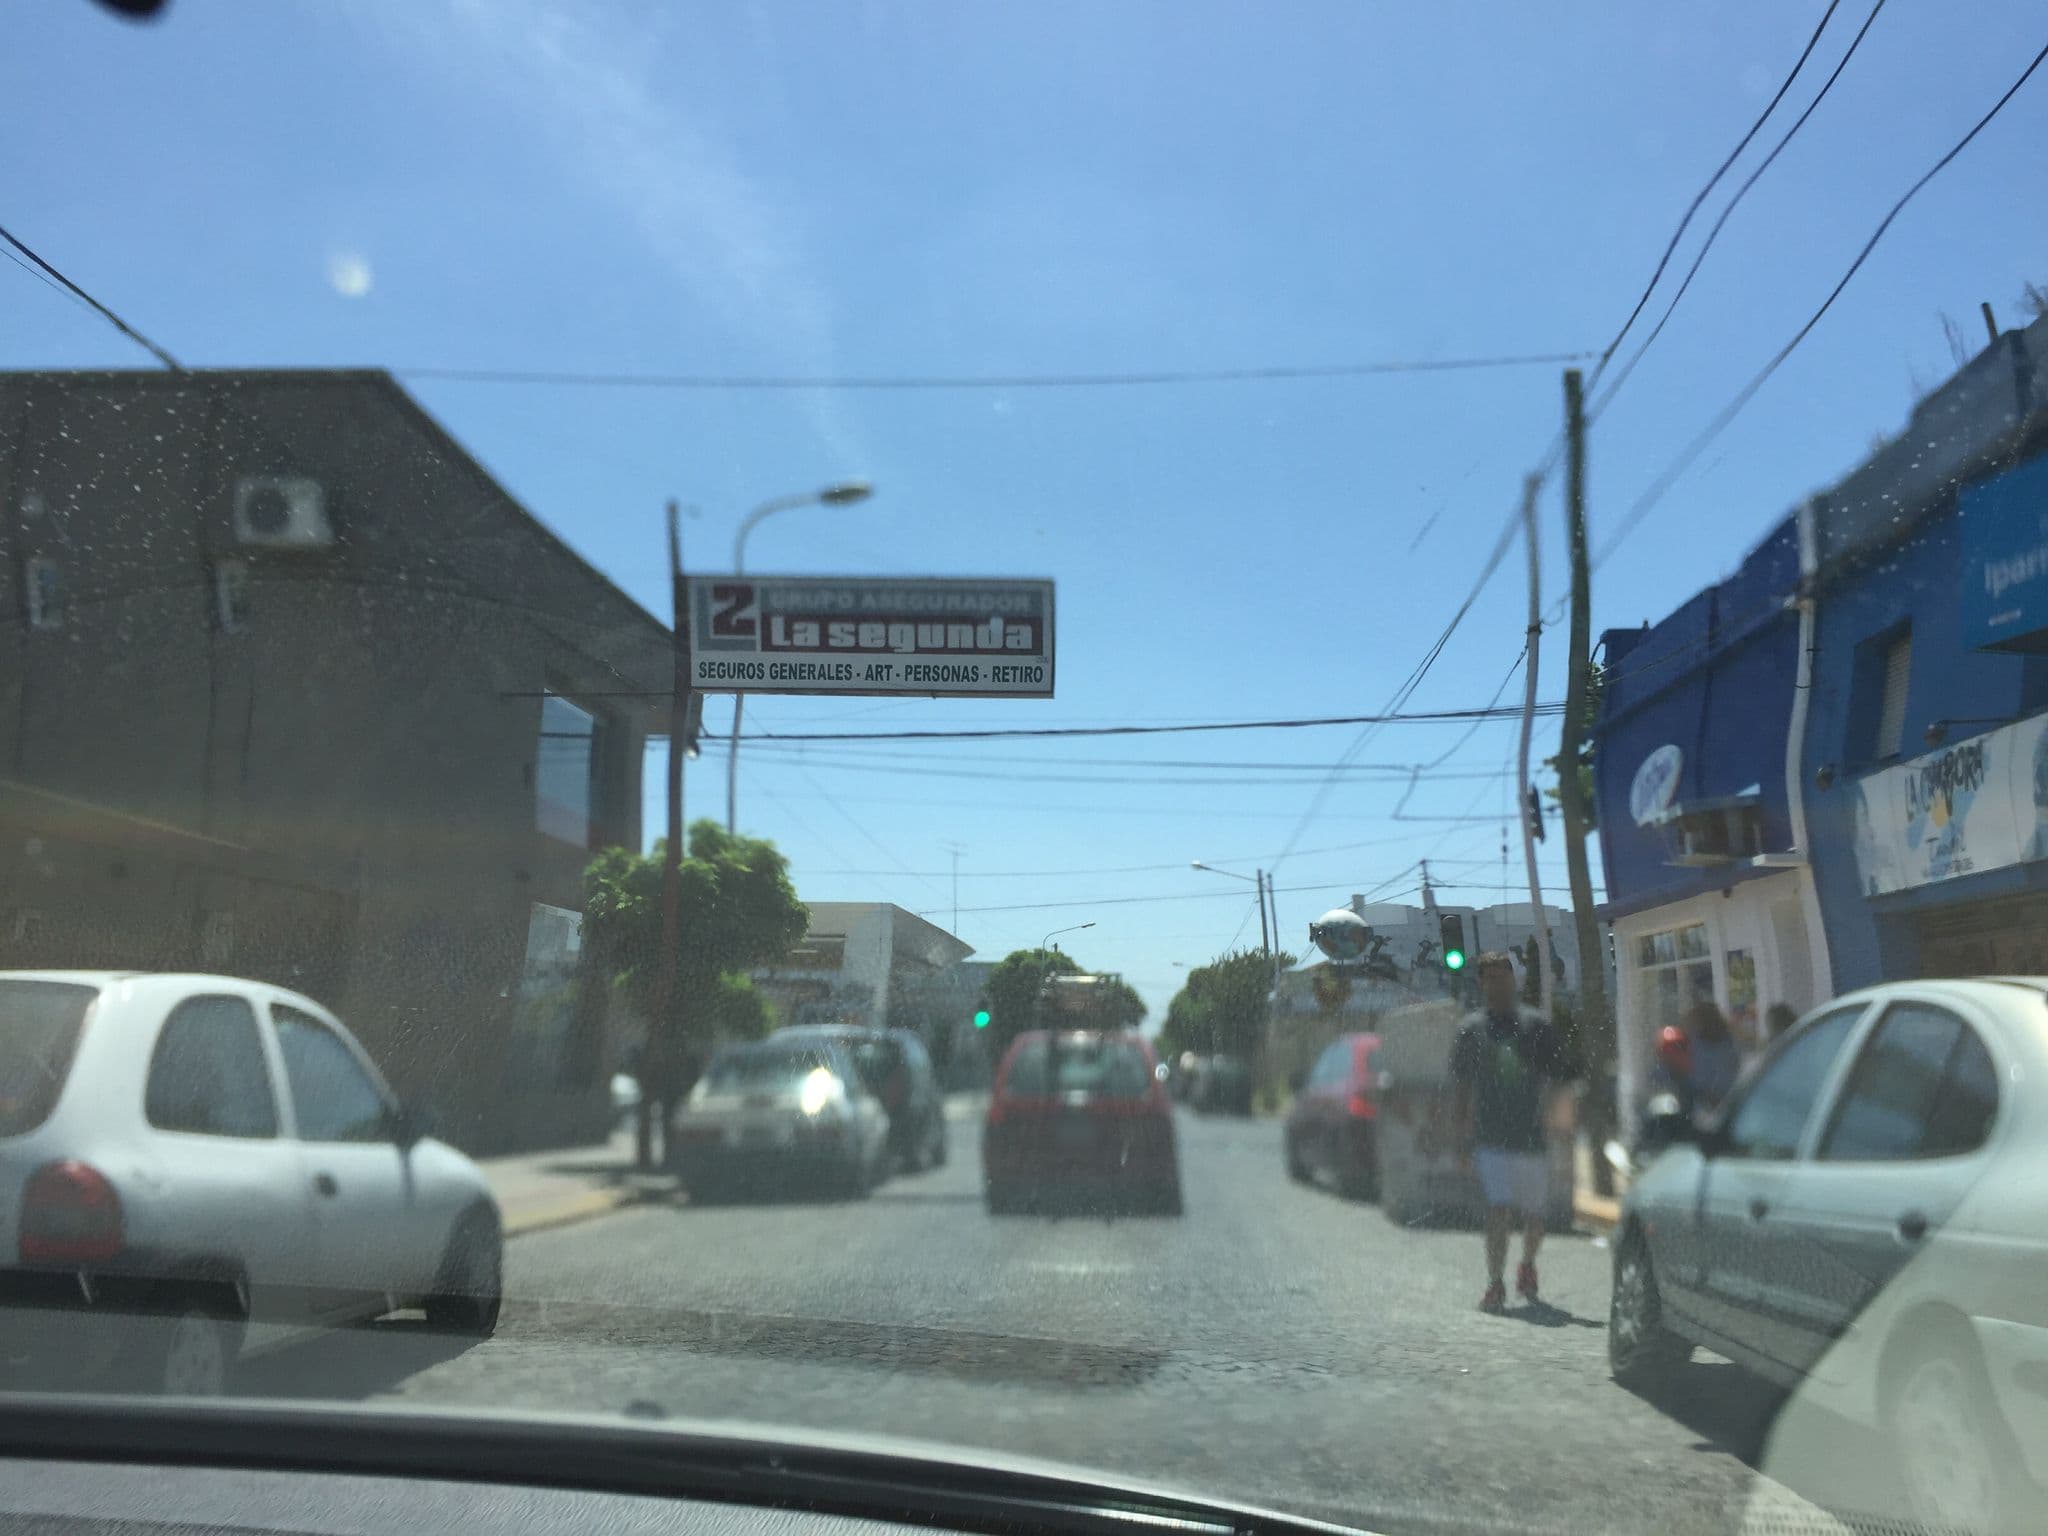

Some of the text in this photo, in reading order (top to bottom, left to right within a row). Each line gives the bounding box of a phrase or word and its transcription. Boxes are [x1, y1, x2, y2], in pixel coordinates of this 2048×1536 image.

[769, 587, 1032, 613] GRUPO ASEGURADOR
[770, 616, 1033, 654] La segunda
[698, 662, 765, 680] SEGUROS
[769, 663, 853, 681] GENERALES
[864, 664, 893, 682] ART
[904, 665, 979, 683] PERSONAS
[991, 665, 1044, 684] RETIRO
